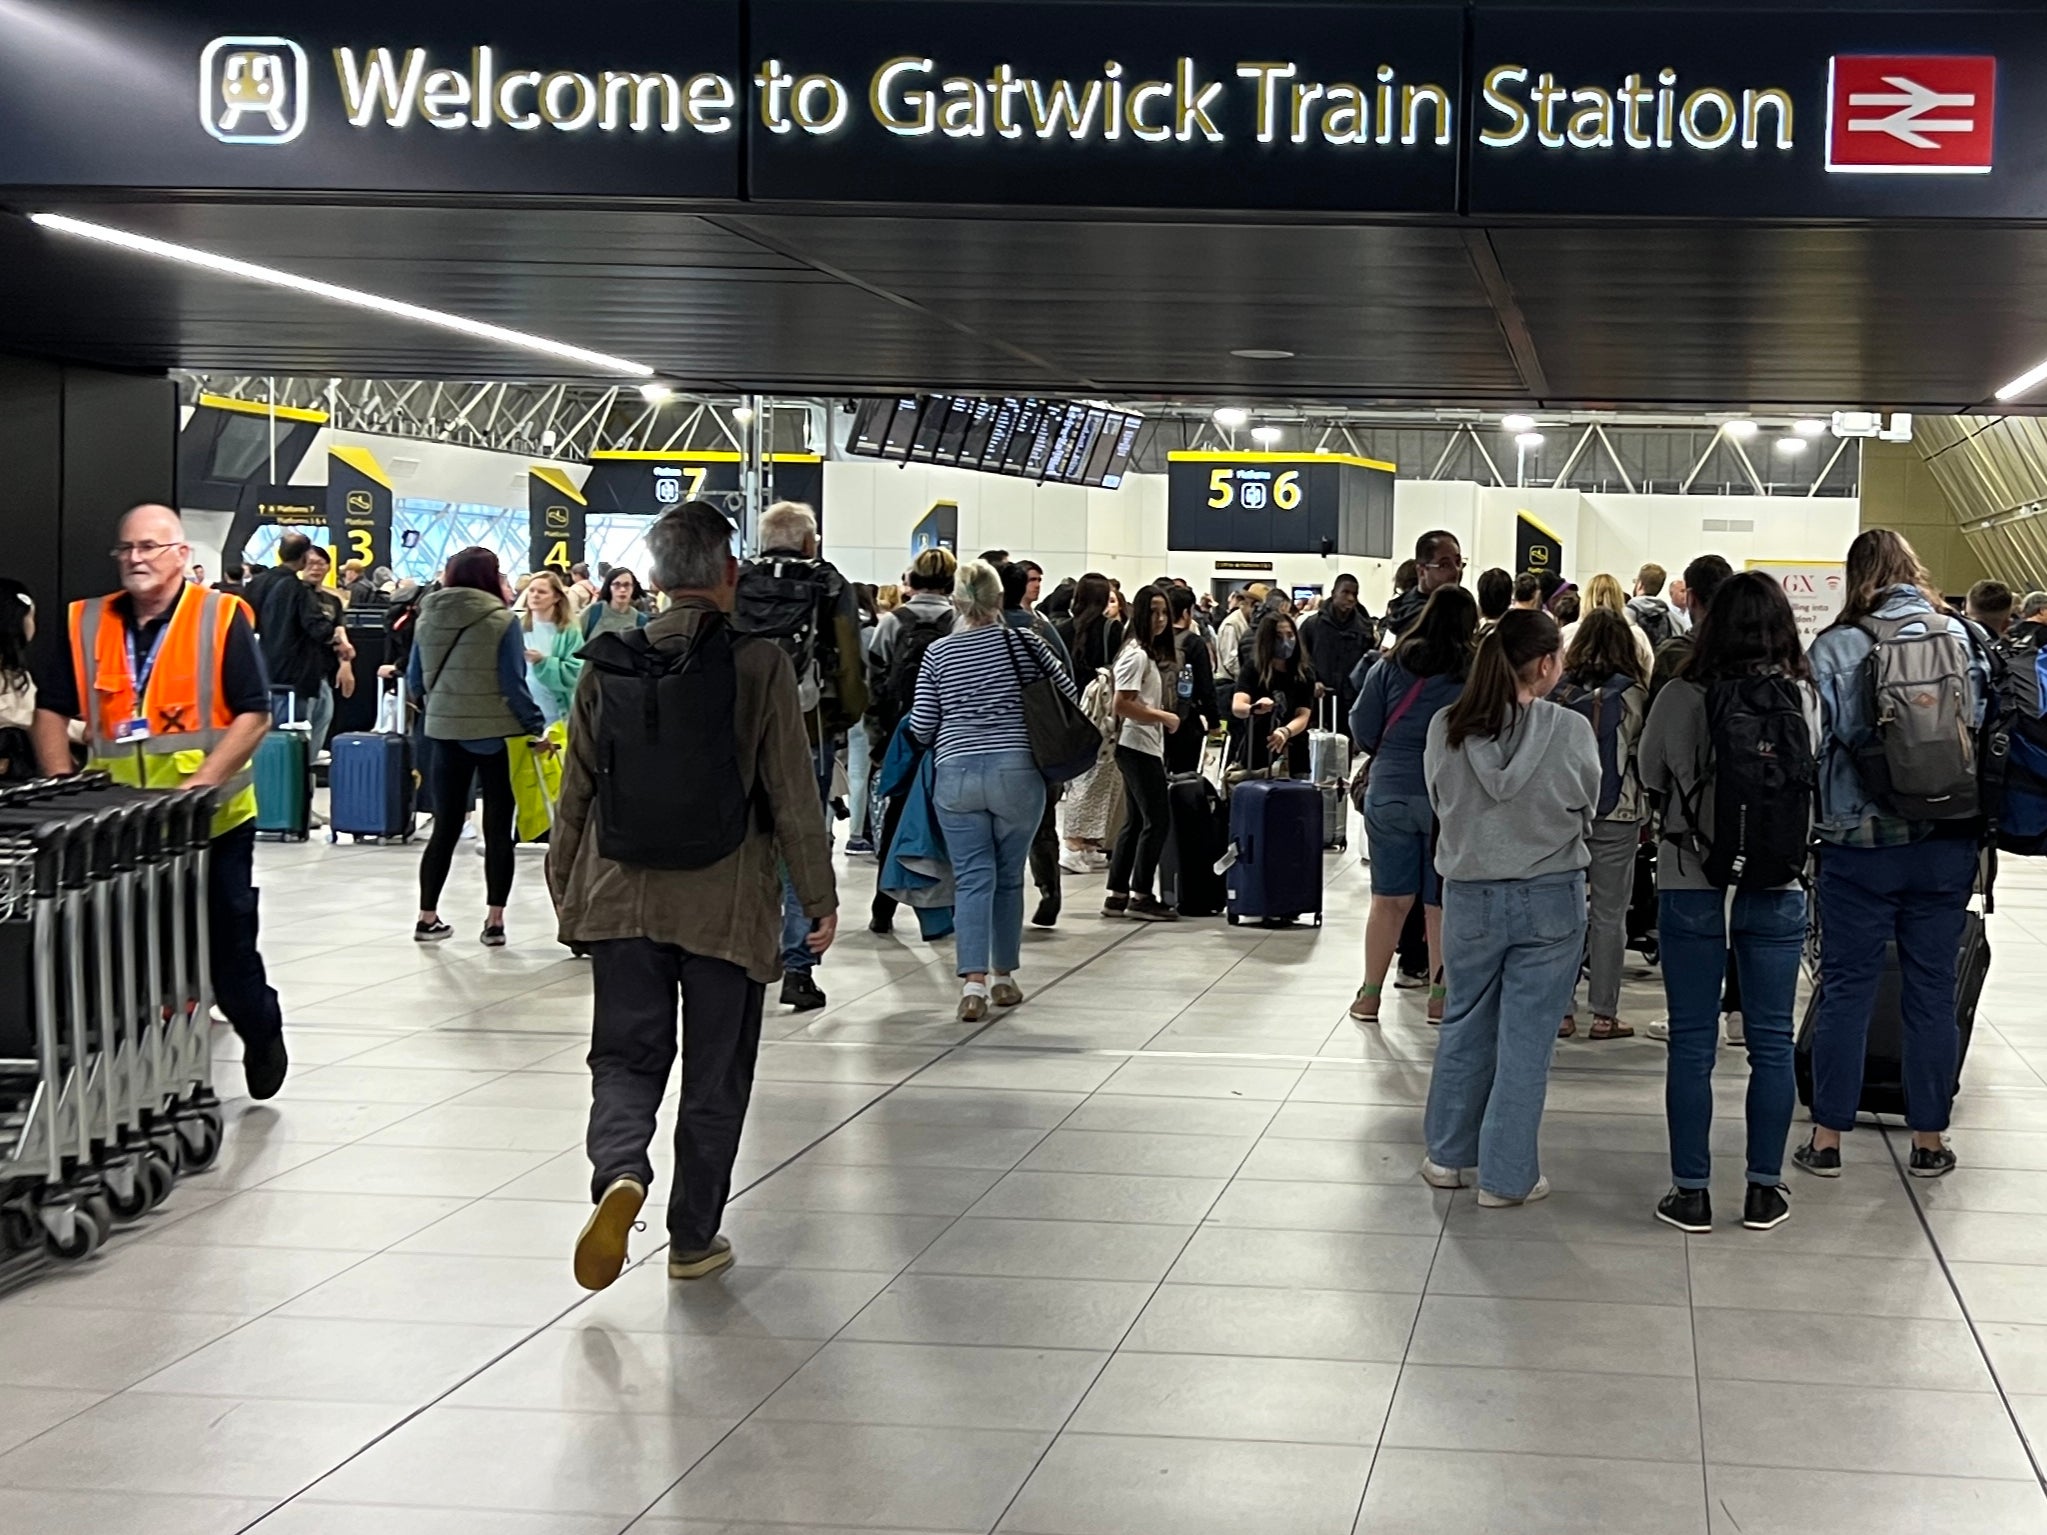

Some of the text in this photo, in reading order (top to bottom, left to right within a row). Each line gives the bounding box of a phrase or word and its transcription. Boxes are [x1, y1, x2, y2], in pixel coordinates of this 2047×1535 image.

[333, 45, 1795, 150] Welcome to Gatwick Train Station
[683, 467, 707, 502] 7
[1207, 469, 1234, 509] 5
[1273, 470, 1301, 510] 6
[347, 529, 374, 567] 3
[543, 541, 571, 573] 4
[1783, 575, 1814, 592] GX
